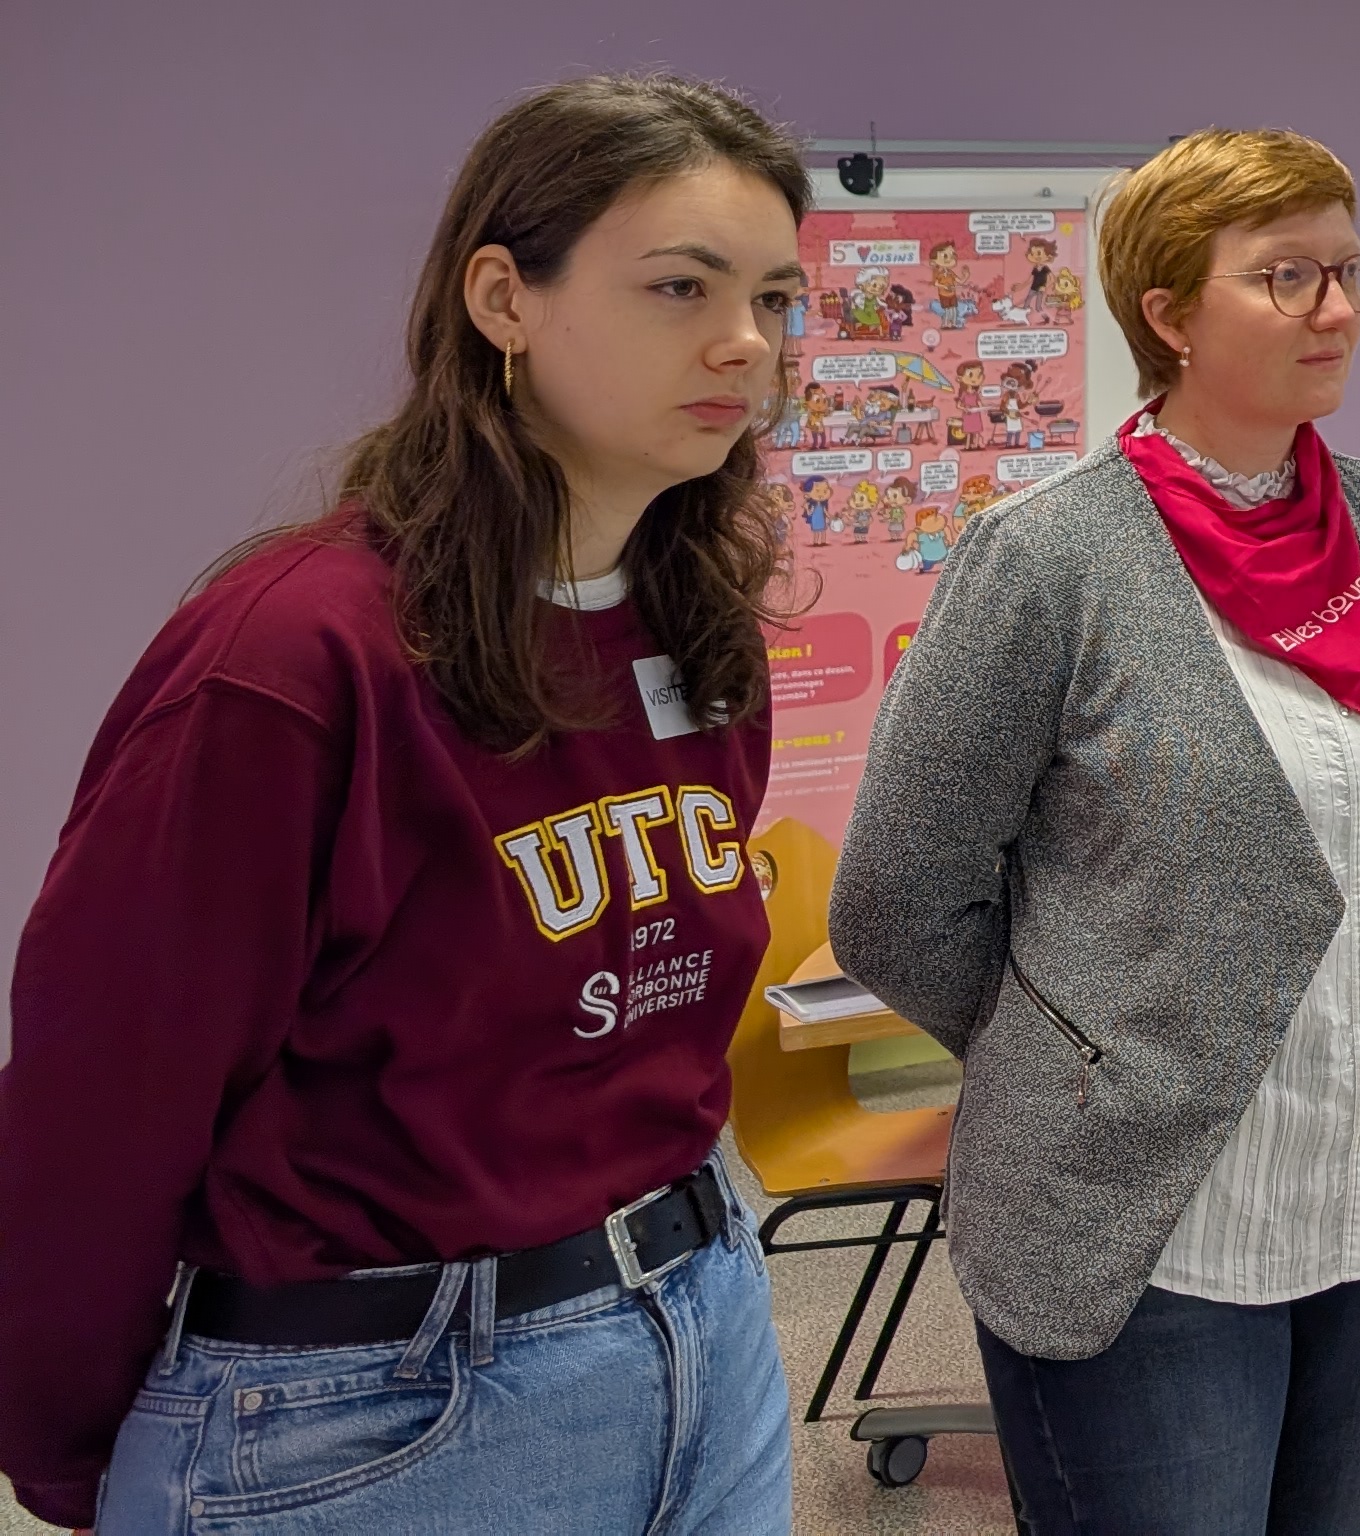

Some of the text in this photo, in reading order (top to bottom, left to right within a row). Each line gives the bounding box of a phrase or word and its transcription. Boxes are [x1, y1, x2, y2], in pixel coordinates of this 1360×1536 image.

[1271, 620, 1323, 652] Elles
[494, 784, 745, 944] UTC
[630, 917, 676, 952] 1972
[628, 949, 714, 986] LLIANCE
